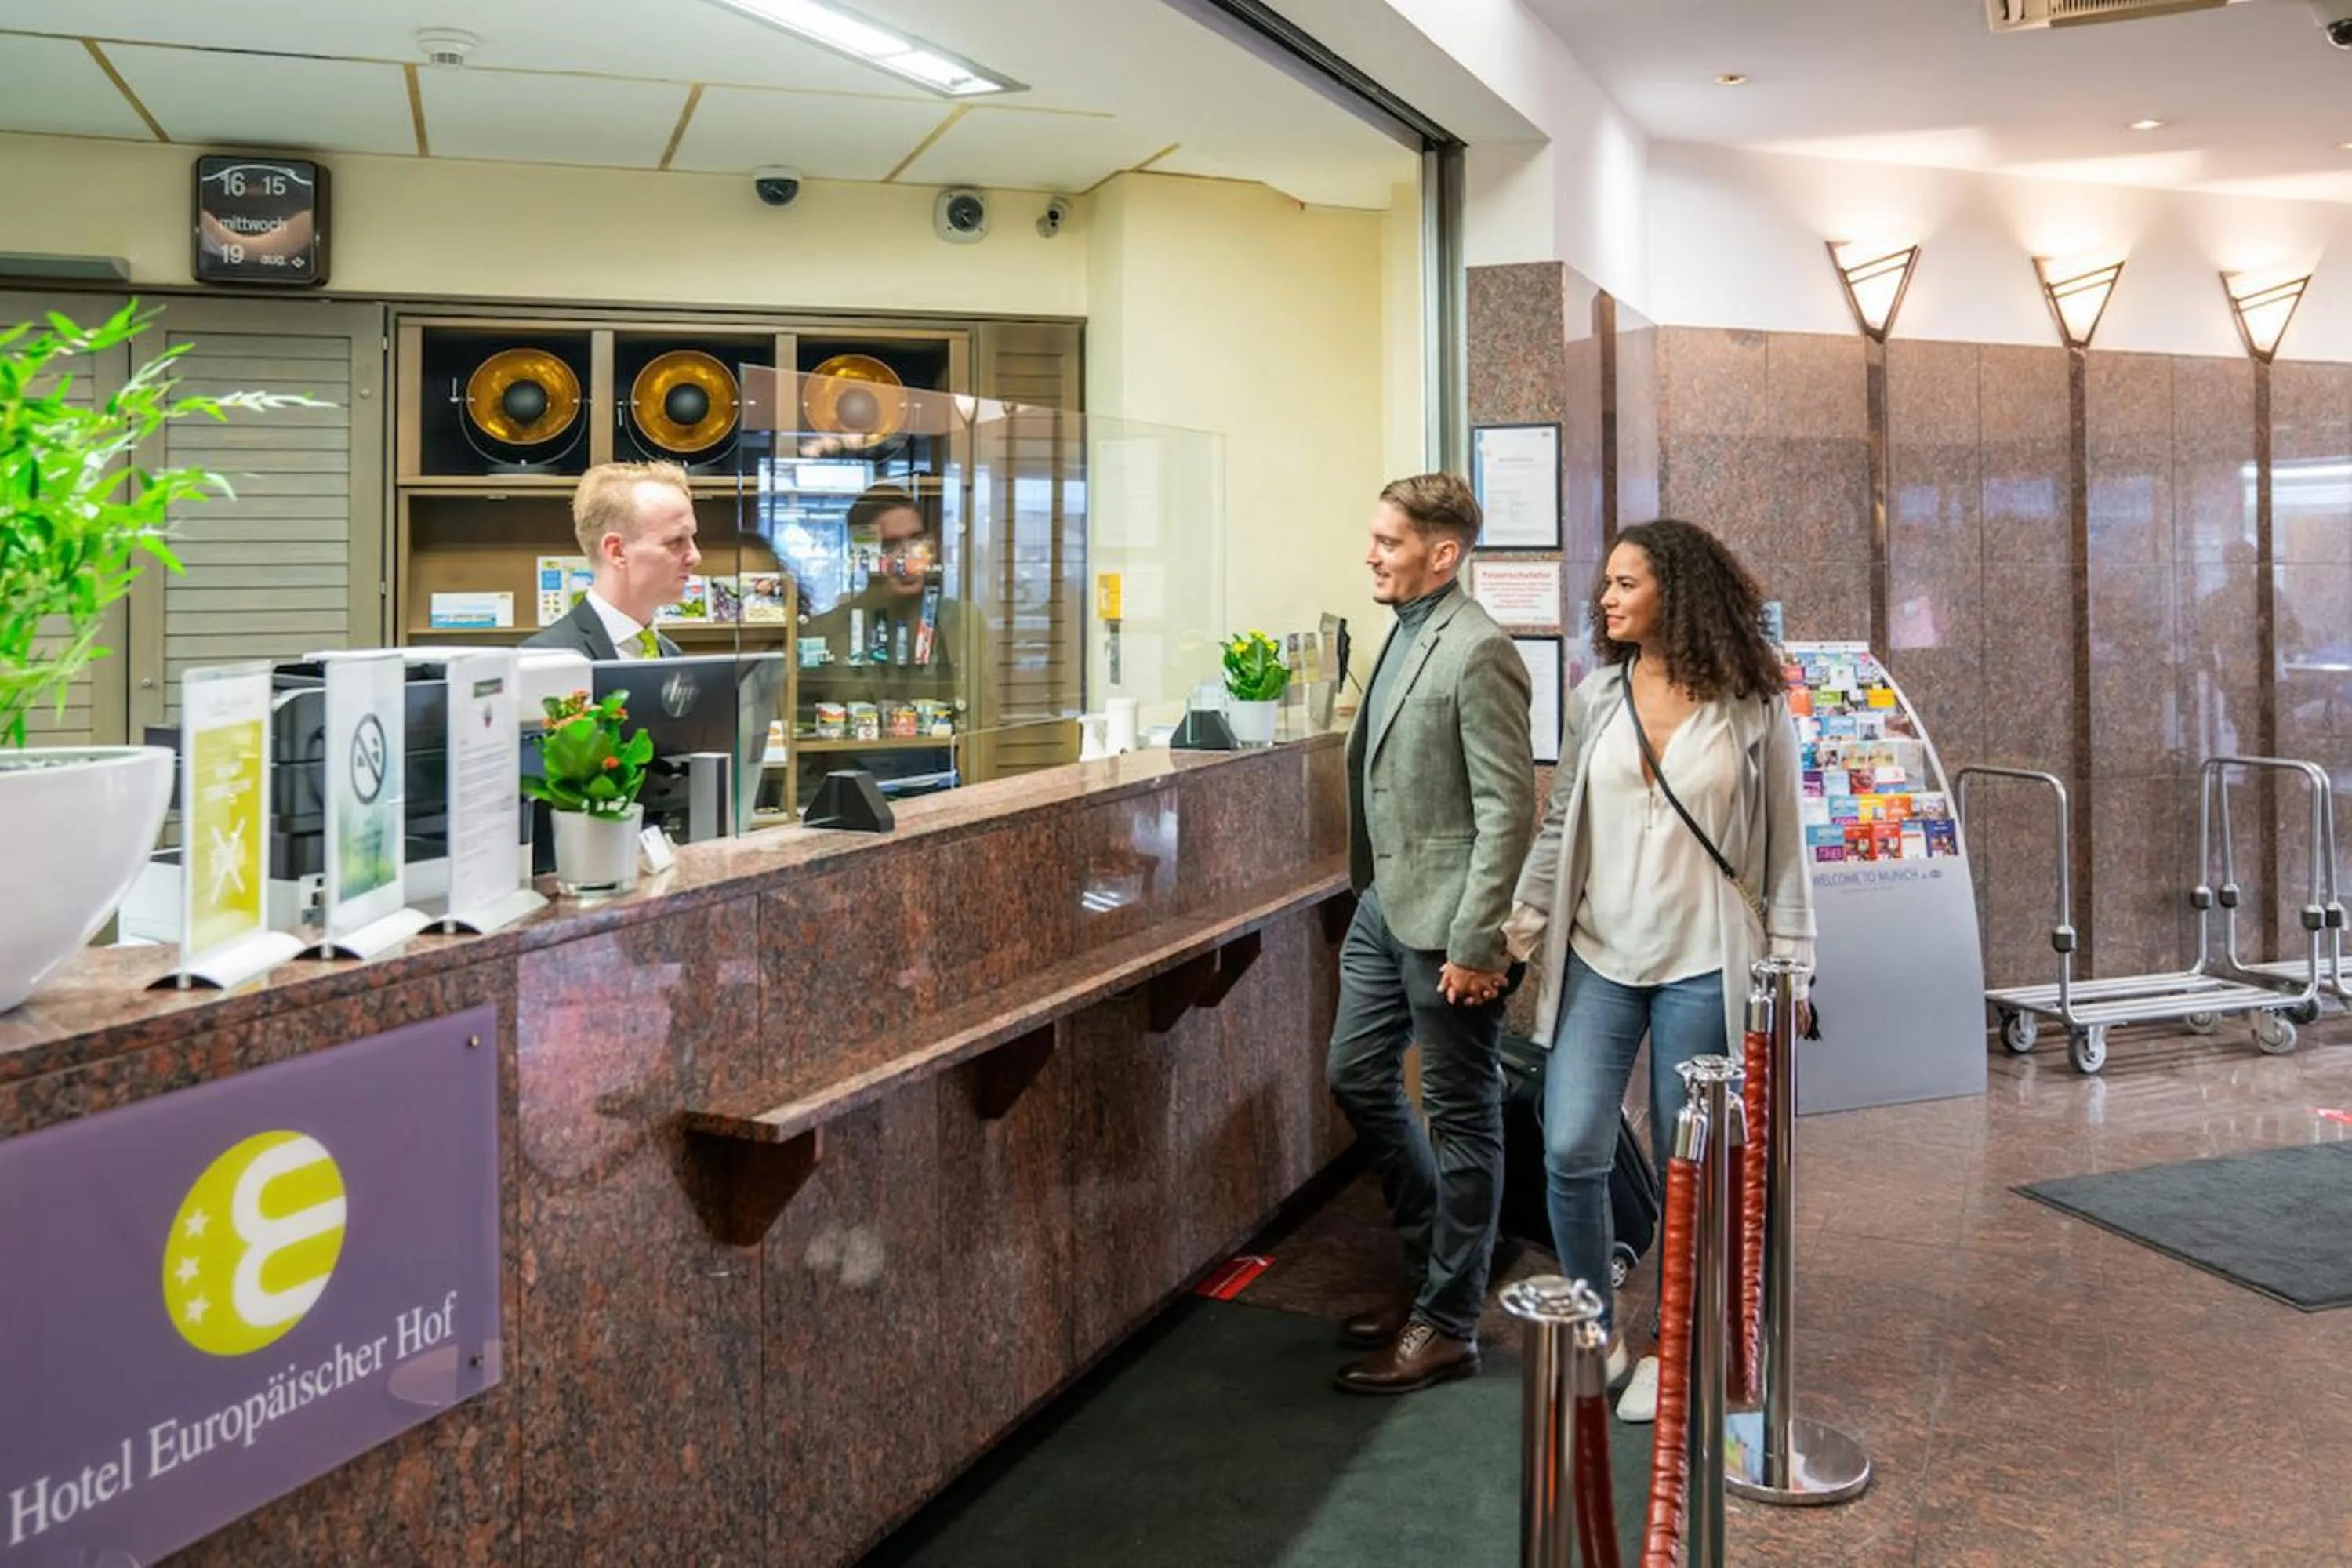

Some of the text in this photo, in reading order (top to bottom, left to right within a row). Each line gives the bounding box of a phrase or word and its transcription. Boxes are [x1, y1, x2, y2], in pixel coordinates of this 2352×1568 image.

[222, 172, 286, 197] 16 15
[219, 215, 287, 232] mittwoch
[220, 244, 244, 264] 19
[8, 1291, 457, 1546] Hotel Europäischer Hof
